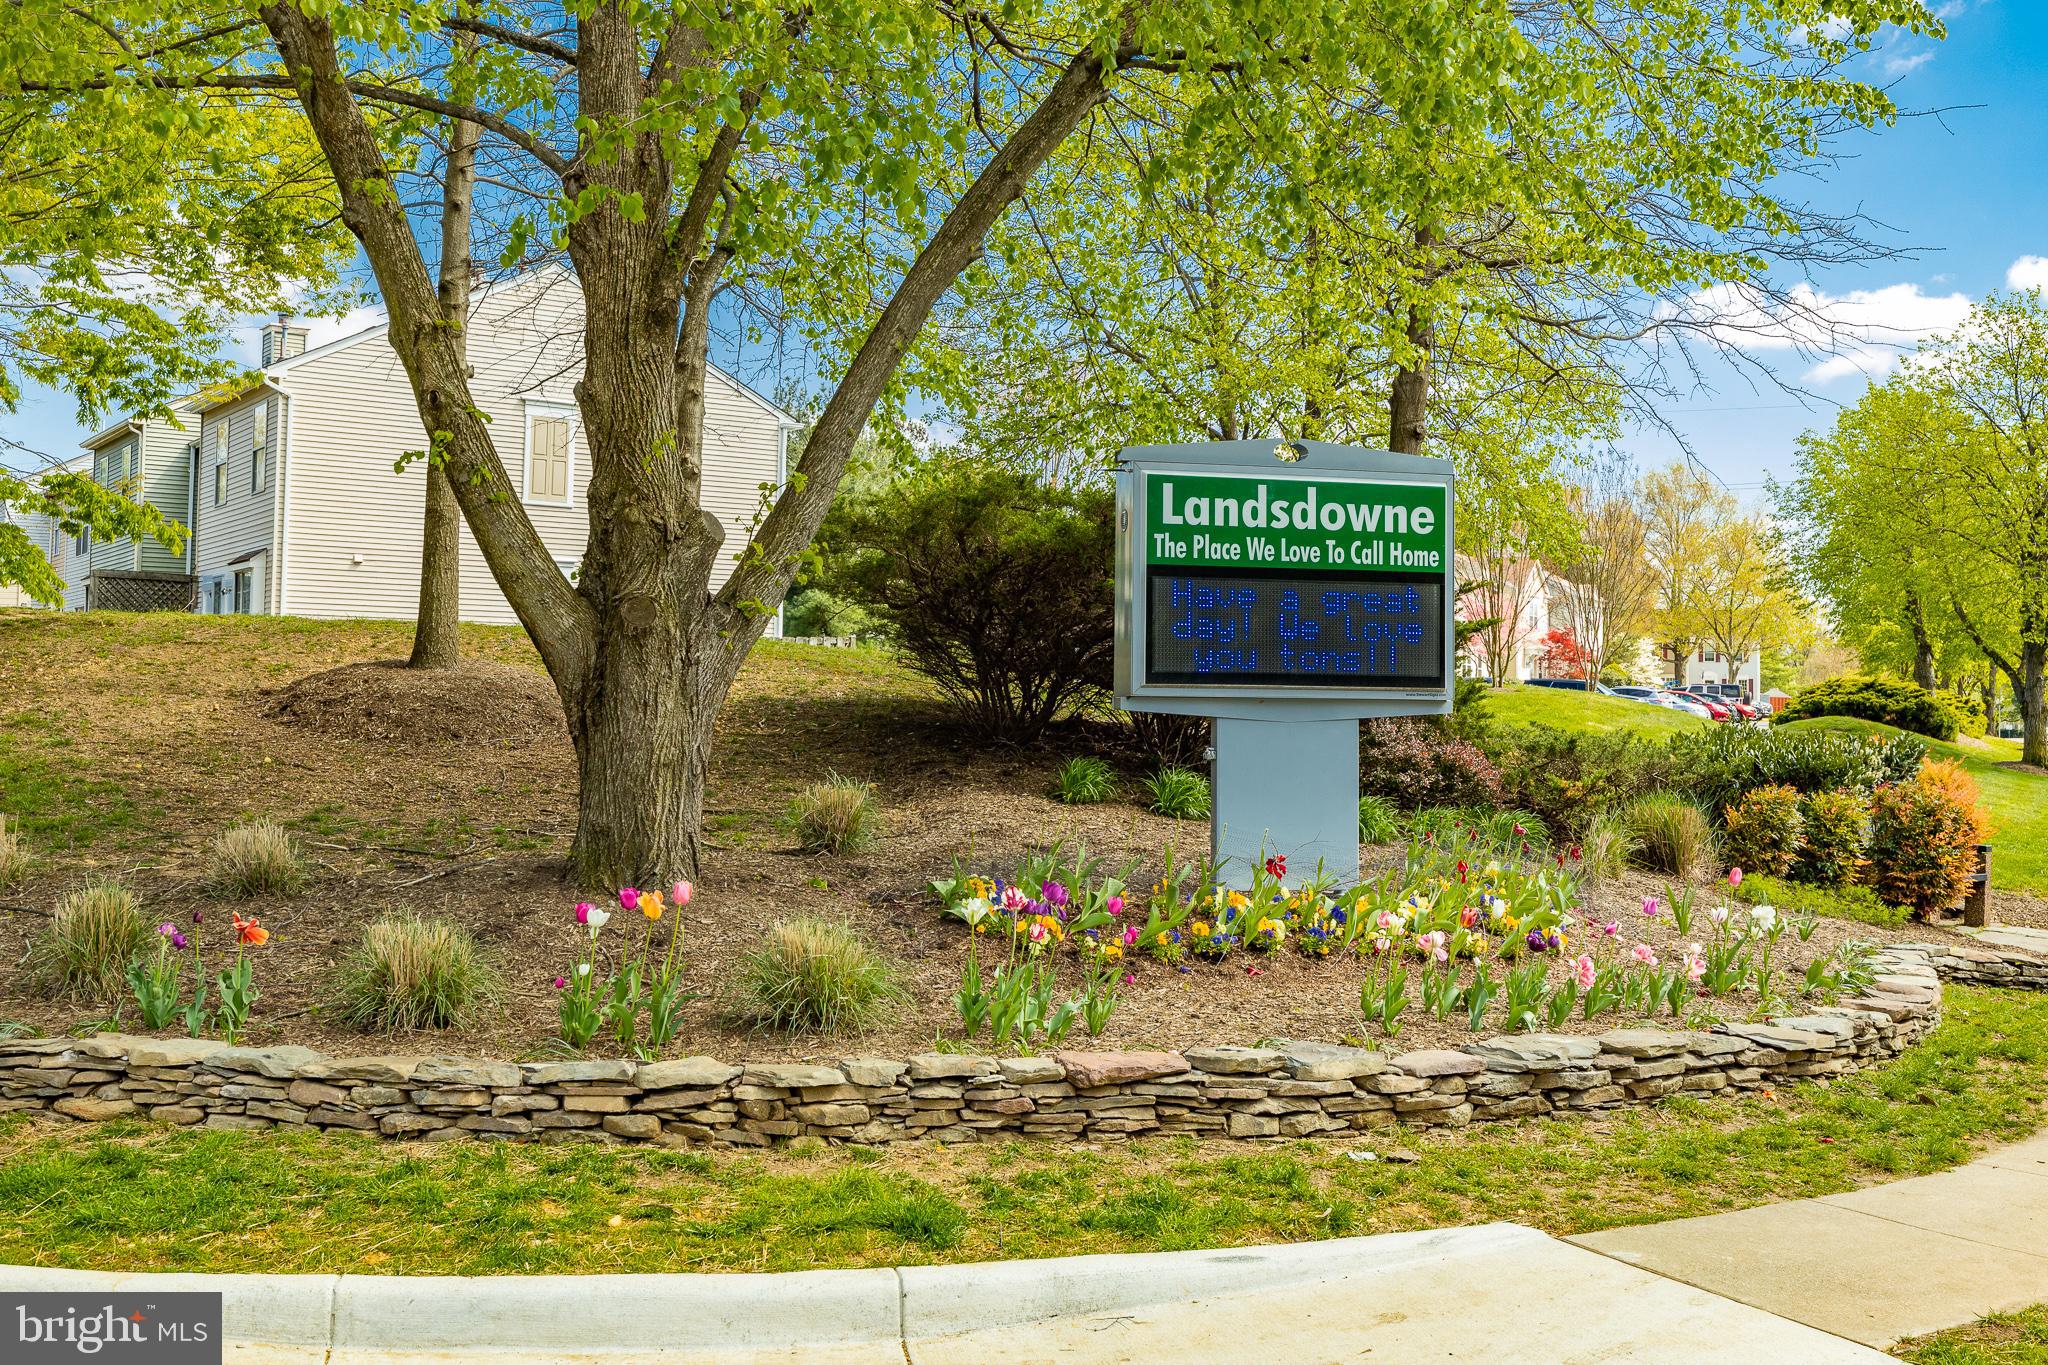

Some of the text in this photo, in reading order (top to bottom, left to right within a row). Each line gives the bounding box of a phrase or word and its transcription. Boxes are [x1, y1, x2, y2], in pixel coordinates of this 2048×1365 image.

[1162, 482, 1435, 534] Landsdowne
[1154, 533, 1439, 567] The Place We Love To Call Home
[1172, 580, 1419, 615] Have a great
[1172, 611, 1423, 642] day! We love
[1194, 644, 1396, 672] you tons!!
